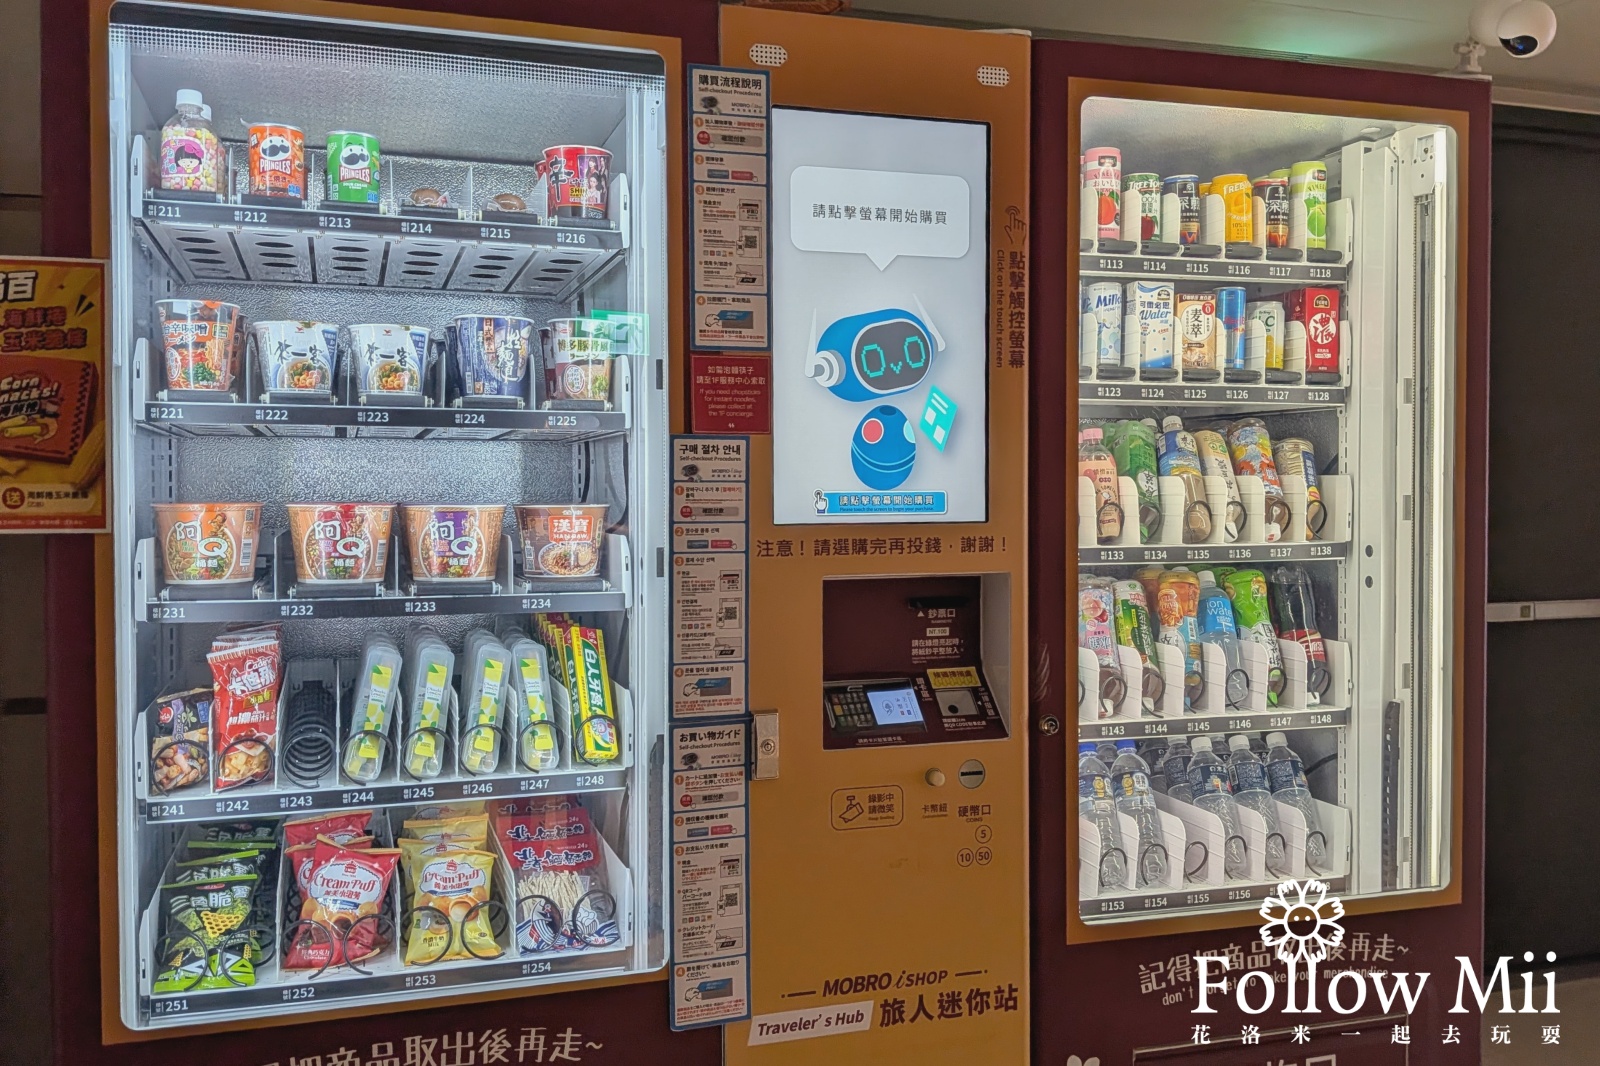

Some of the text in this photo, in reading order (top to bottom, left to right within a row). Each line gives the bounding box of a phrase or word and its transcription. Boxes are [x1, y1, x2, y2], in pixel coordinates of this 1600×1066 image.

[698, 74, 762, 91] 購買流程說明
[259, 159, 292, 175] PRINGLES
[339, 166, 371, 183] PRINGLES
[548, 155, 574, 203] 辛
[1129, 181, 1148, 191] TREE
[158, 205, 181, 218] 211
[244, 211, 268, 223] 212
[812, 203, 948, 226] 請點擊螢幕開始購買
[328, 216, 351, 228] 213
[410, 222, 432, 234] 214
[489, 227, 511, 239] 215
[565, 232, 586, 244] 216
[1106, 260, 1123, 269] 113
[1150, 262, 1166, 271] 114
[1192, 264, 1209, 273] 115
[1234, 265, 1250, 275] 116
[1276, 267, 1292, 276] 117
[1316, 269, 1332, 278] 118
[996, 250, 1005, 369] Click on the touch screen
[1008, 251, 1026, 370] 點擊觸控螢幕
[1139, 310, 1171, 320] Water
[1, 375, 40, 391] Corn
[1104, 387, 1122, 397] 123
[1148, 388, 1165, 398] 124
[1190, 389, 1207, 398] 125
[1232, 390, 1248, 399] 126
[1274, 391, 1290, 400] 127
[1314, 392, 1330, 401] 128
[160, 407, 184, 419] 221
[265, 409, 289, 421] 222
[366, 411, 389, 423] 223
[463, 414, 485, 425] 224
[556, 415, 577, 426] 225
[679, 444, 741, 455] 구매 절차 안내
[839, 494, 935, 507] 請點擊螢幕開始購買
[553, 518, 589, 533] 漢寶
[1107, 551, 1124, 560] 133
[1151, 550, 1167, 559] 134
[1193, 550, 1210, 559] 135
[1235, 549, 1252, 558] 136
[1276, 548, 1292, 557] 137
[1316, 546, 1332, 555] 138
[414, 601, 436, 612] 233
[530, 599, 551, 609] 234
[1206, 600, 1224, 608] ion
[162, 607, 186, 619] 231
[290, 605, 314, 616] 232
[584, 647, 603, 712] 白人牙膏
[1235, 719, 1252, 728] 146
[1276, 717, 1292, 726] 147
[1316, 715, 1332, 724] 148
[1108, 725, 1125, 735] 143
[1151, 724, 1168, 733] 144
[1194, 722, 1210, 731] 145
[679, 729, 742, 743] お買い物ガイド
[679, 743, 713, 751] Self-checkout
[528, 779, 550, 790] 247
[584, 775, 604, 786] 248
[412, 787, 434, 798] 245
[471, 783, 493, 794] 246
[289, 796, 312, 807] 243
[352, 791, 374, 802] 244
[867, 792, 894, 804] 錄影中
[161, 804, 185, 816] 241
[226, 800, 250, 812] 242
[868, 803, 895, 815] 請微笑
[958, 804, 991, 818] 硬幣口
[960, 850, 990, 863] 10 50
[423, 868, 481, 885] Cream Puff
[313, 873, 377, 892] Cream Puff
[1193, 894, 1210, 904] 155
[1235, 890, 1251, 899] 156
[1108, 901, 1125, 911] 153
[1151, 897, 1168, 907] 154
[531, 962, 551, 974] 254
[414, 975, 436, 986] 253
[822, 972, 893, 998] MOBRO
[292, 987, 315, 999] 252
[1162, 985, 1194, 1006] don't
[165, 1000, 188, 1012] 251
[879, 983, 1019, 1028] 旅人迷你站
[835, 1009, 865, 1027] Hub
